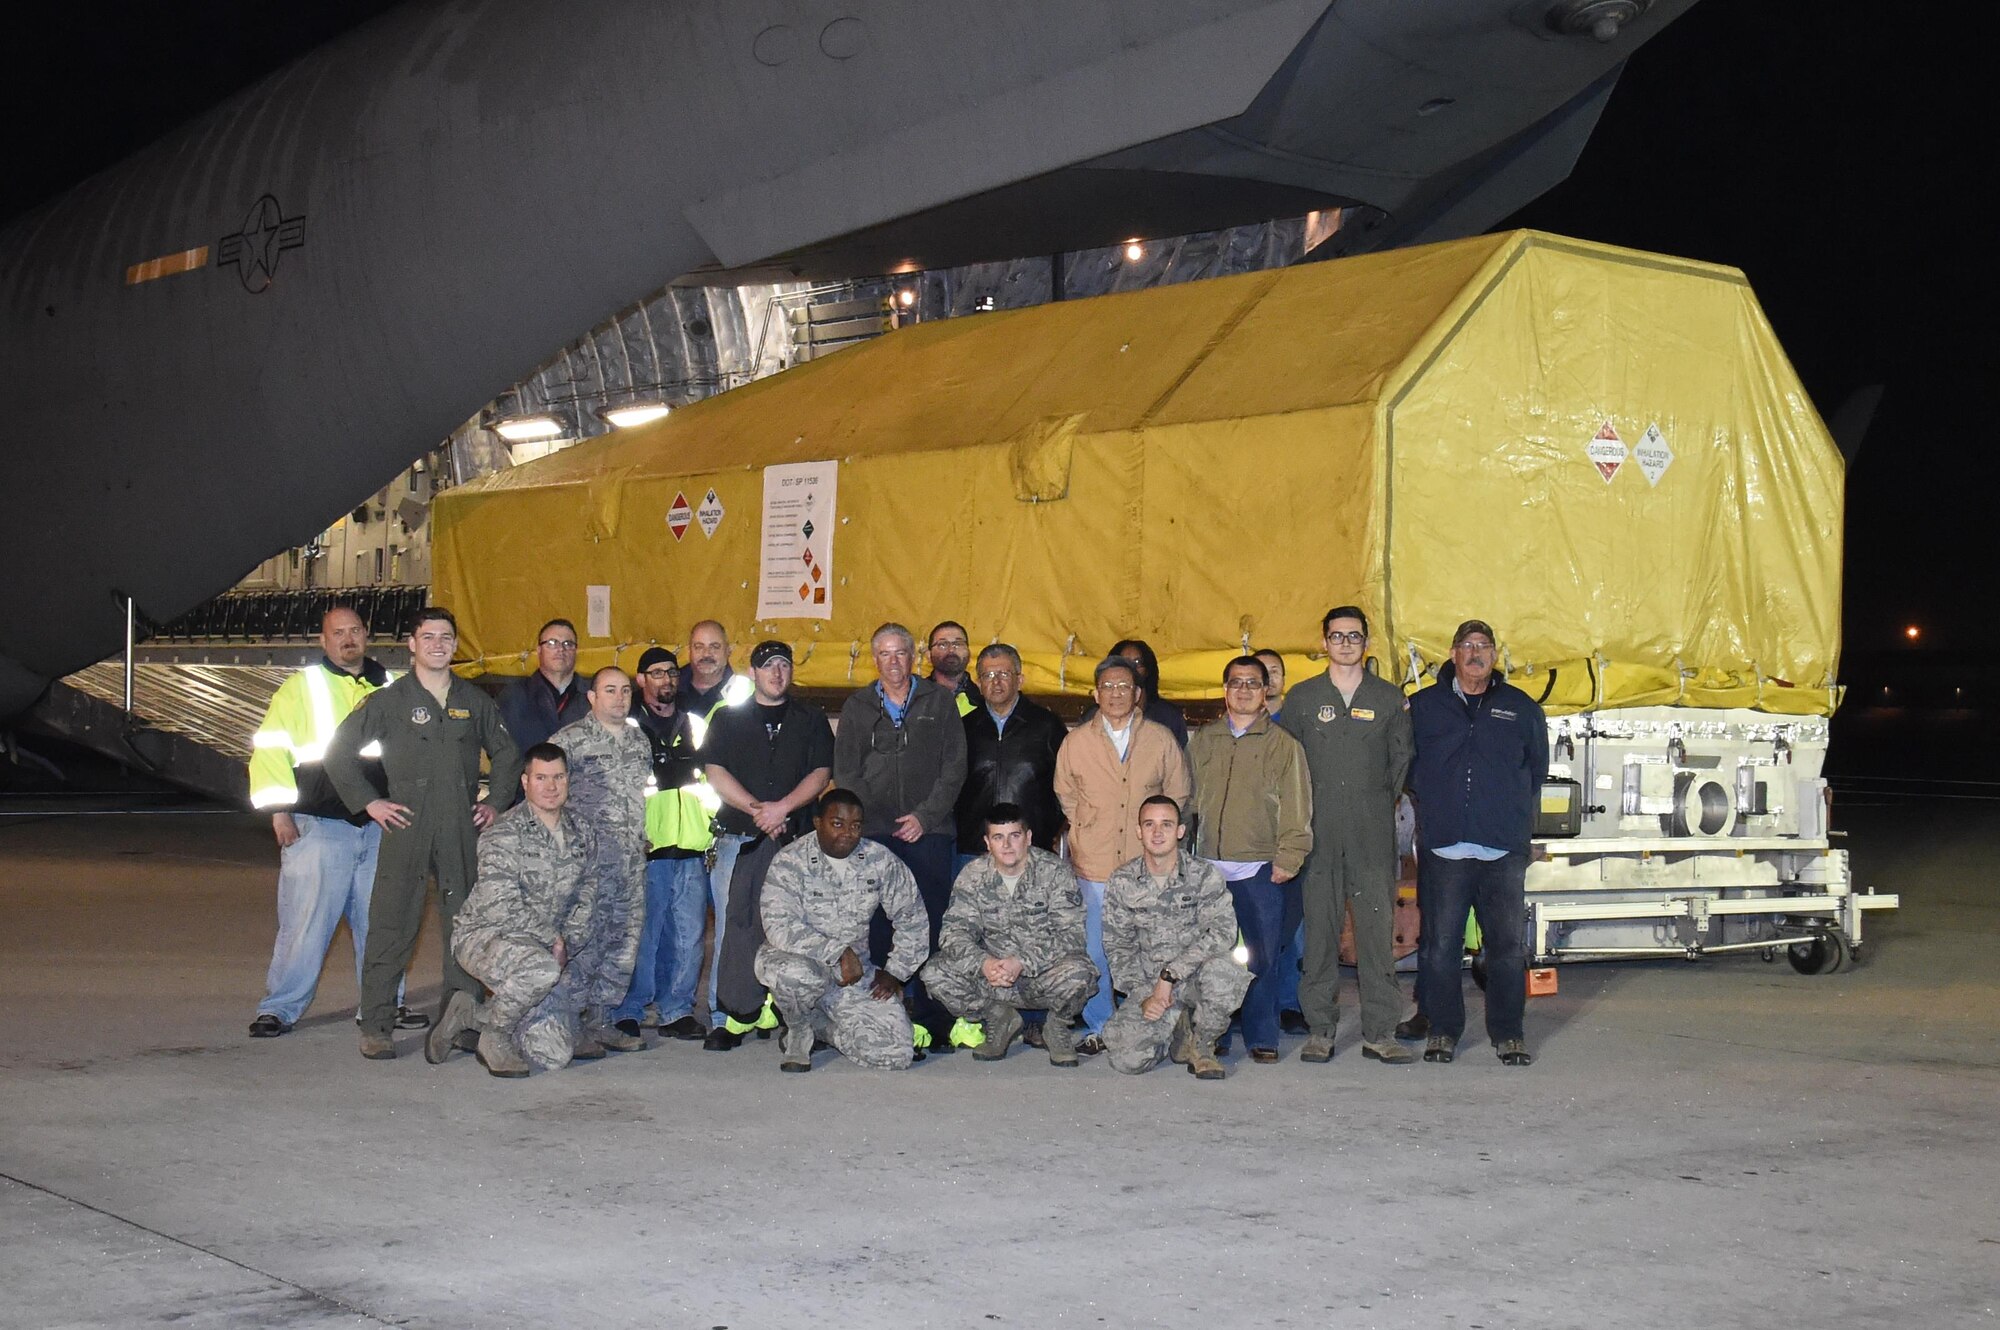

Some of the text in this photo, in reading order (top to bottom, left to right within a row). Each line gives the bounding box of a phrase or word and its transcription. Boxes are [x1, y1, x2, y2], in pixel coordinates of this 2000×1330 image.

[1590, 445, 1624, 457] DANGEROUS
[1637, 448, 1669, 459] INHALATION
[1642, 459, 1664, 468] HAZARD
